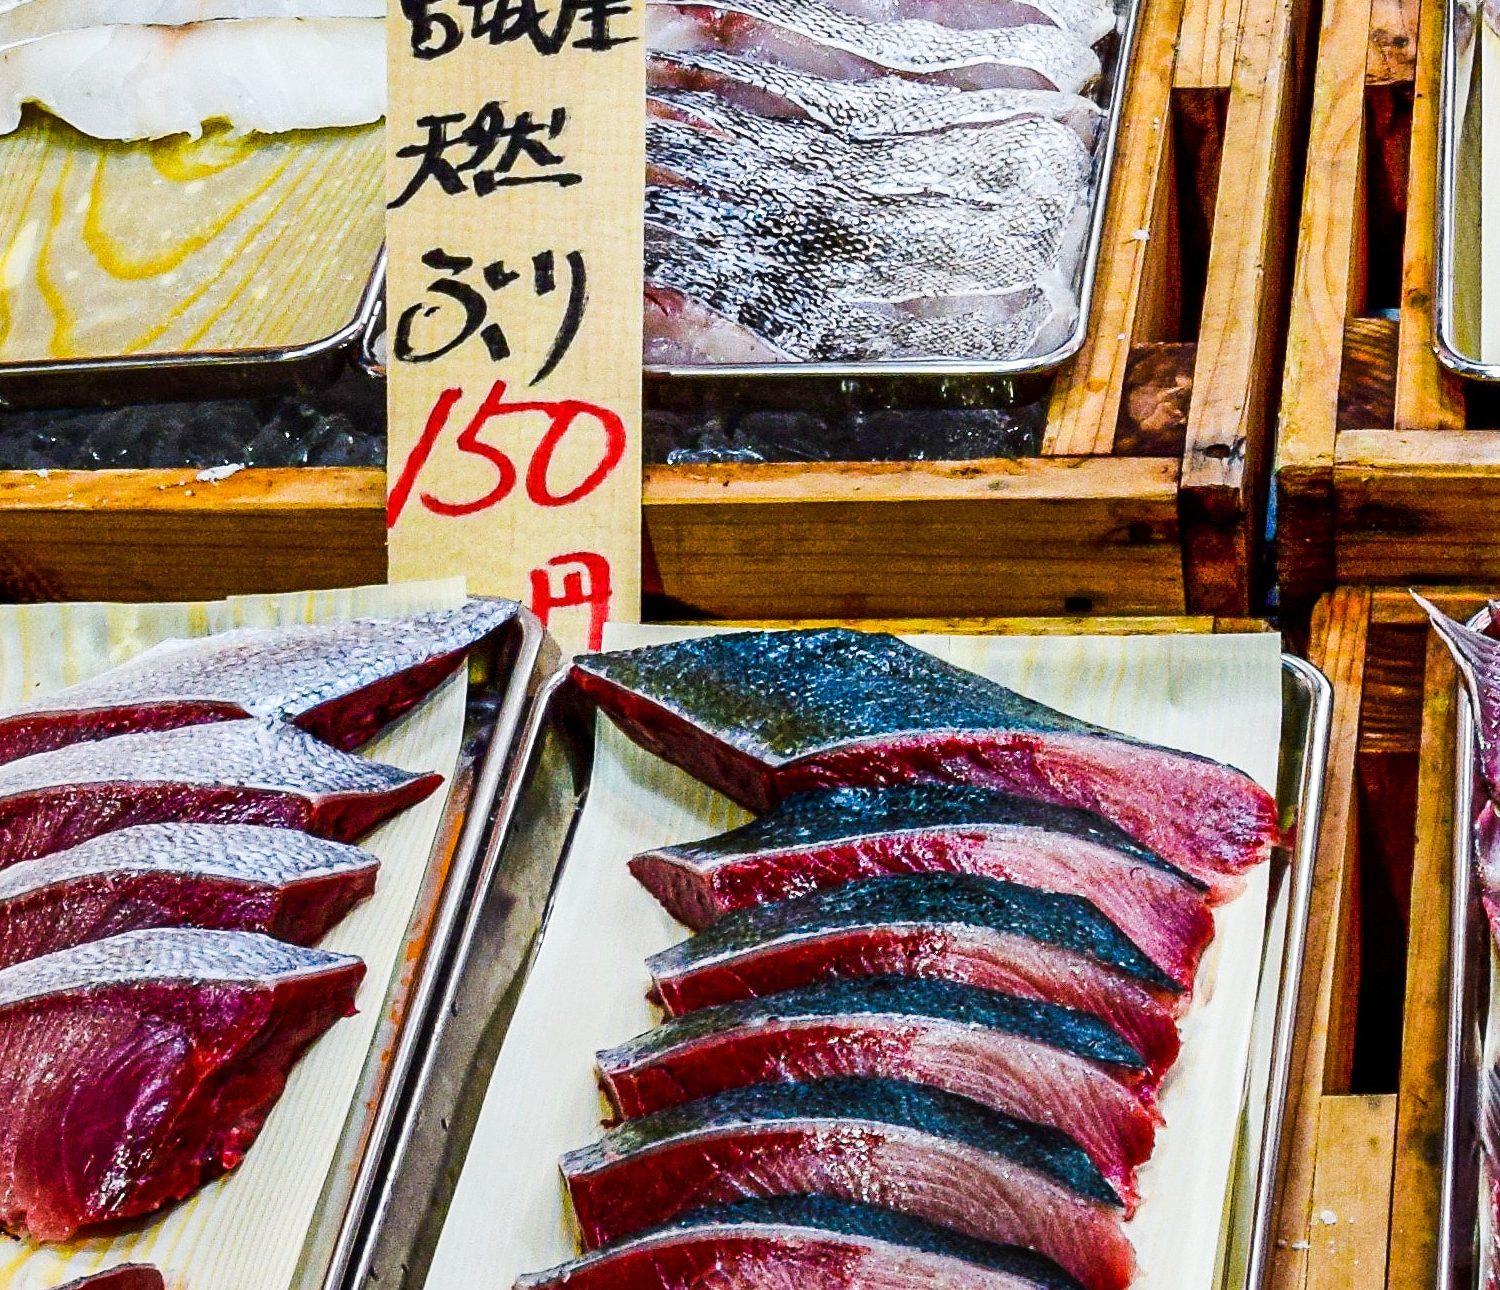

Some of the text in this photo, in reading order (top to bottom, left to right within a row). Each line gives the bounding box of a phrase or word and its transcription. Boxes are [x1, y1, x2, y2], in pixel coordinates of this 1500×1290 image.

[386, 101, 582, 209] 天然
[395, 247, 589, 386] ぶり
[386, 379, 627, 528] 150
[530, 550, 613, 653] 円
